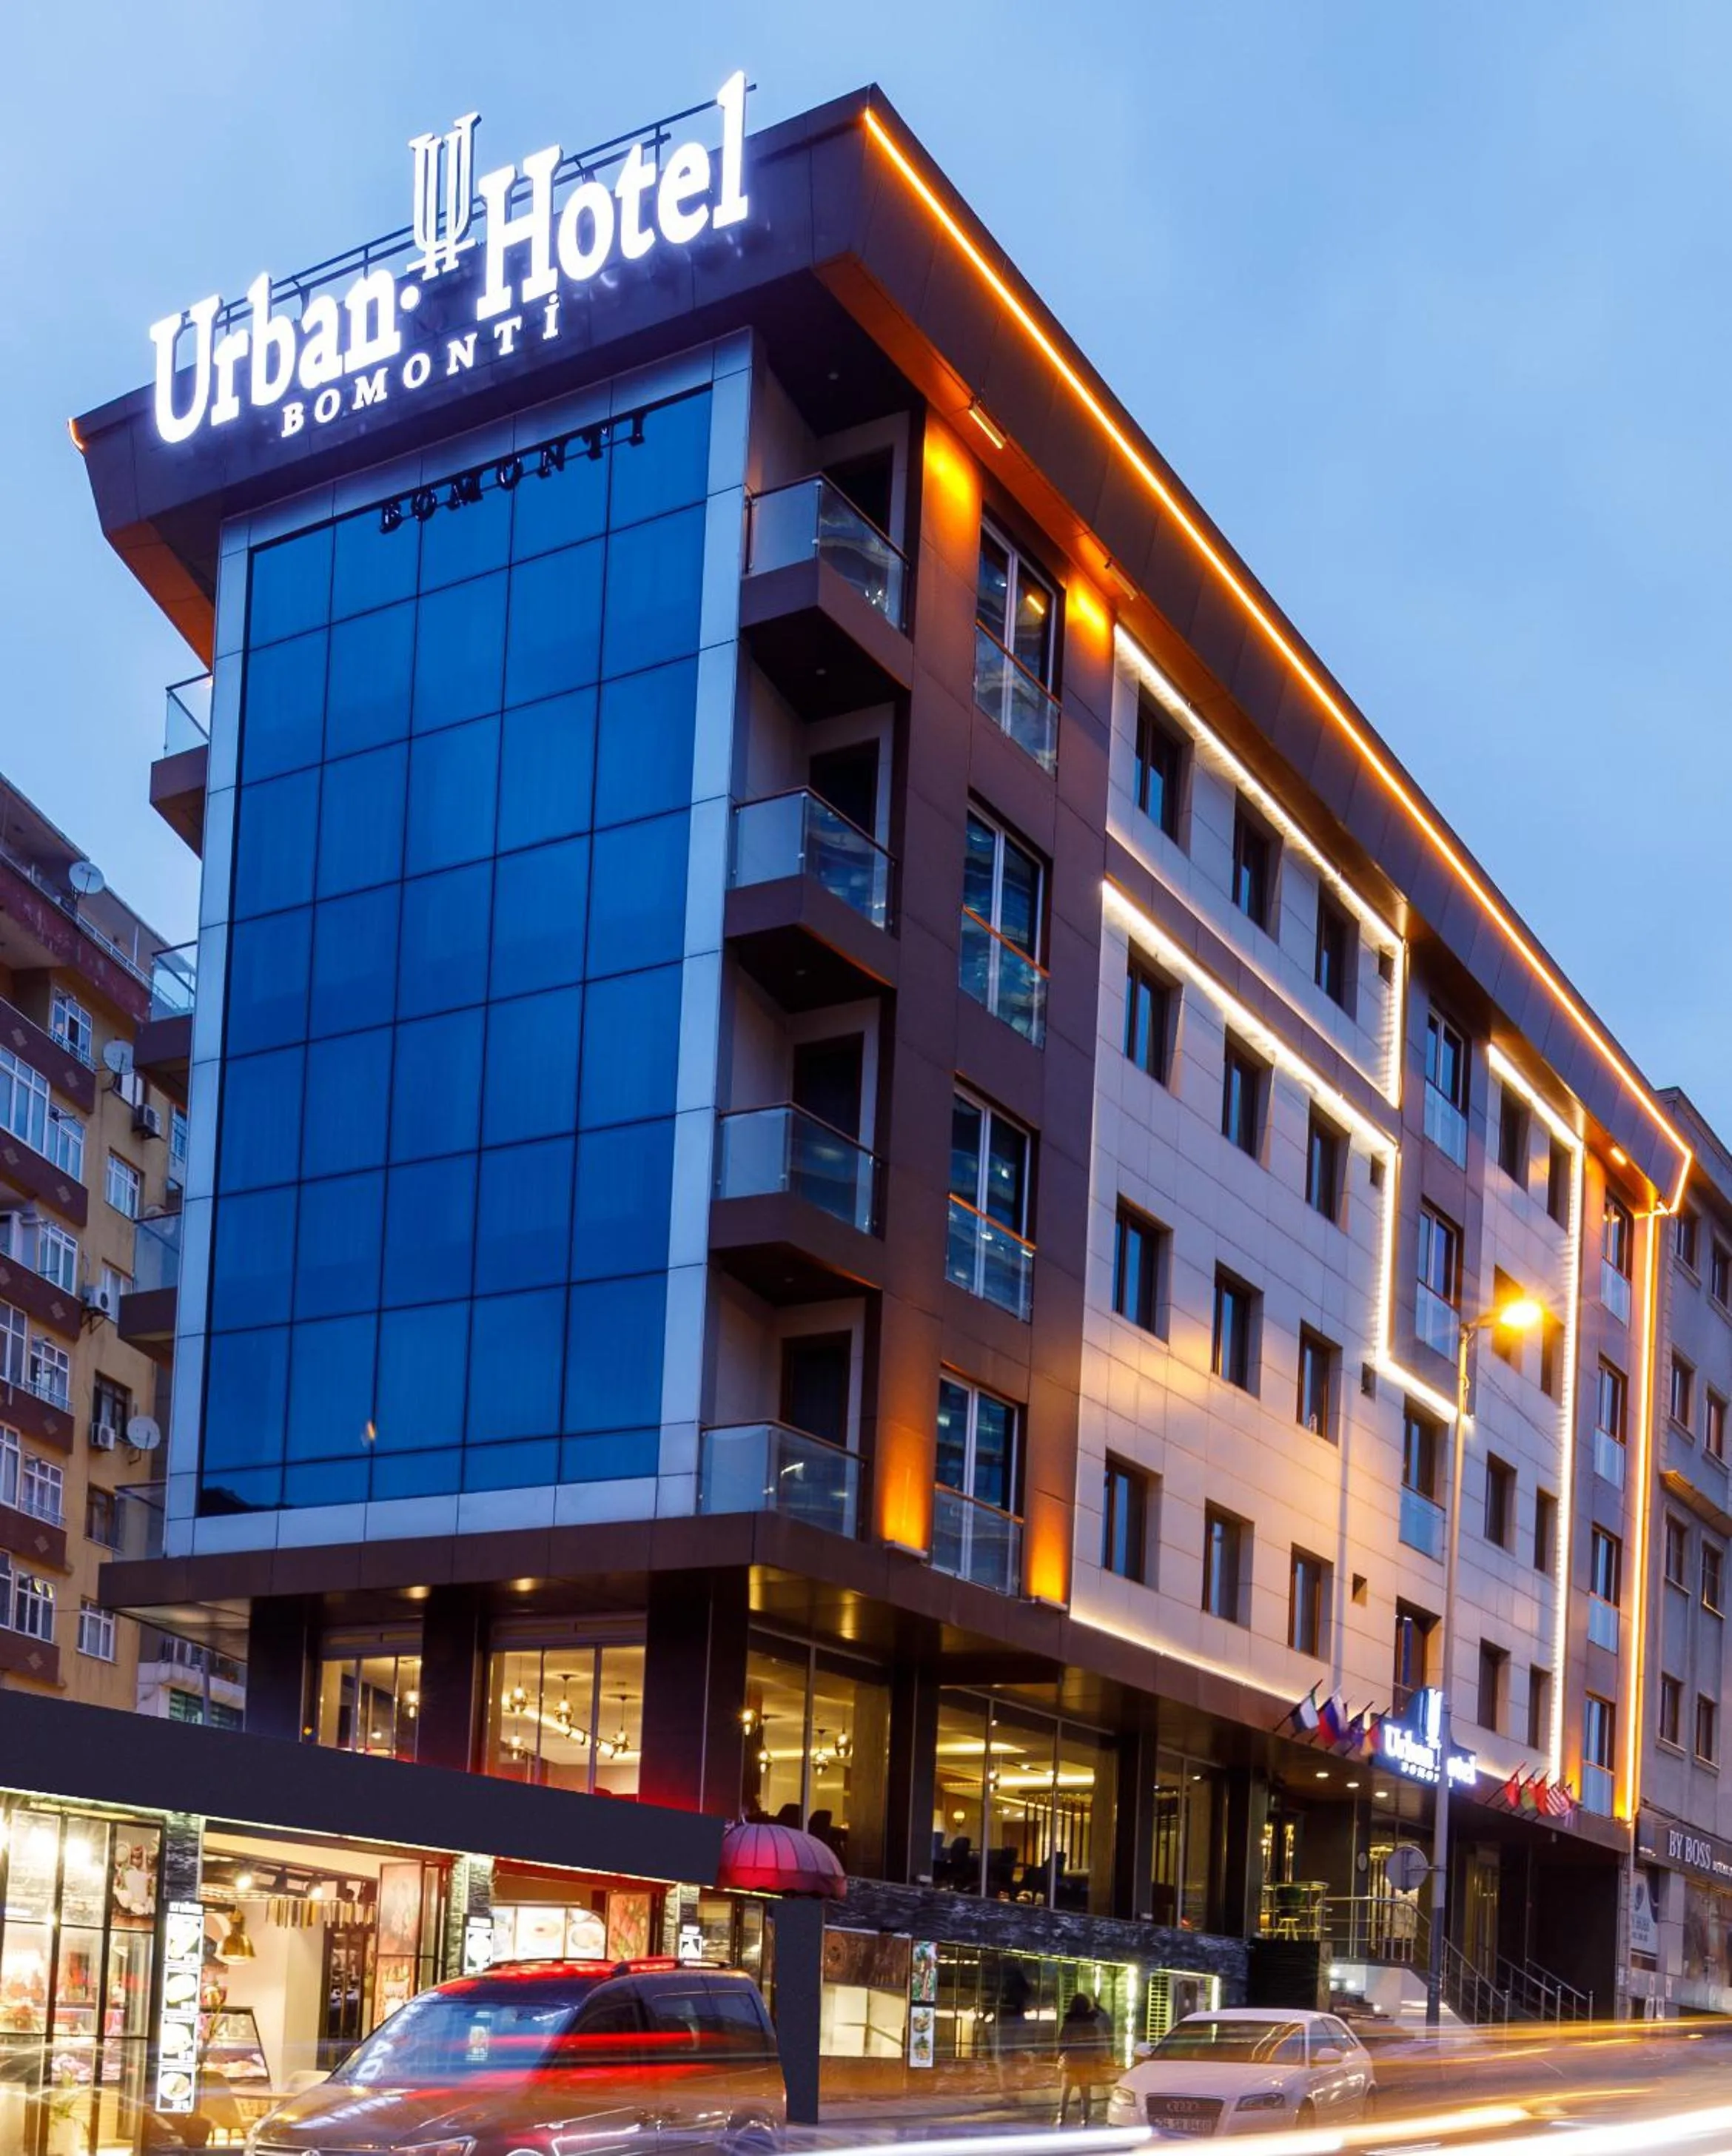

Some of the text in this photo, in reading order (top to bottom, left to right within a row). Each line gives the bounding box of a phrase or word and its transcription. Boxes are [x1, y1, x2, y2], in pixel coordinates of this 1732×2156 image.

[477, 70, 750, 323] Hotel
[1668, 1829, 1684, 1859] BY
[1684, 1836, 1711, 1870] BOSS
